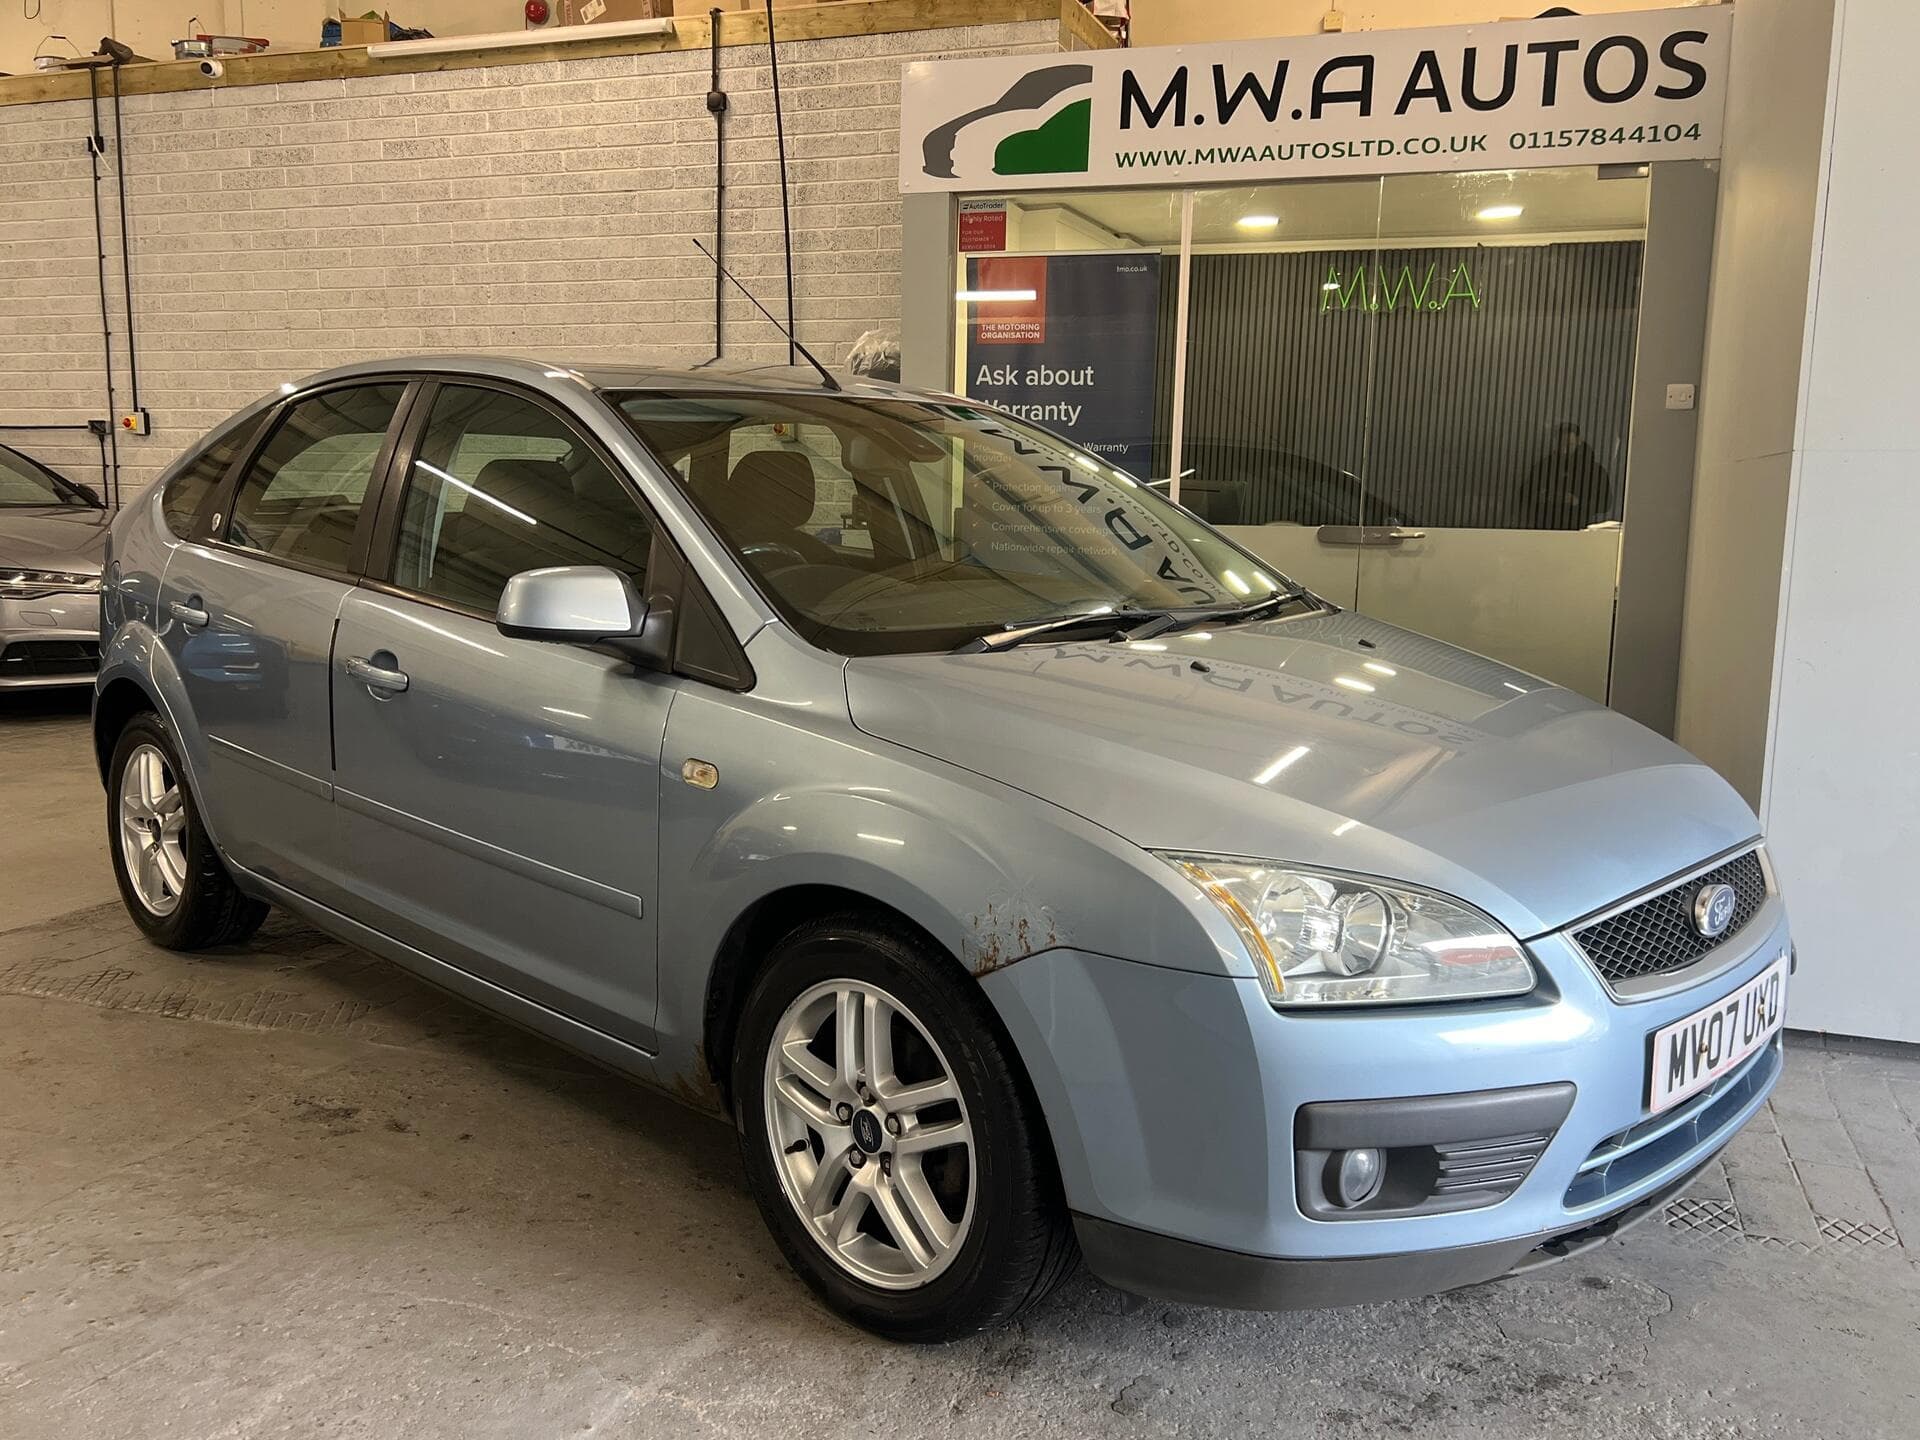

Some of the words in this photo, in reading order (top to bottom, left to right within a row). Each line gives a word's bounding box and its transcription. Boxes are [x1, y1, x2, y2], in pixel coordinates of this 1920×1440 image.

[1119, 54, 1375, 130] M.W.A
[1394, 30, 1709, 116] AUTOS
[1115, 134, 1488, 168] WWW.MWAAUTOSLTD.CO.UK
[1509, 123, 1702, 151] 01157844104
[981, 323, 996, 331] THE
[997, 323, 1040, 332] MOTORING
[981, 331, 1040, 340] ORGANISATION
[976, 364, 1019, 387] Ask
[1025, 364, 1095, 387] about
[1083, 441, 1129, 455] Warranty
[992, 480, 1042, 492] Protection
[991, 502, 1020, 513] Cover
[1023, 502, 1037, 513] for
[1038, 505, 1051, 516] up
[1053, 503, 1064, 514] to
[1065, 503, 1074, 514] 3
[991, 542, 1045, 553] Nationwide
[1667, 999, 1740, 1094] MV07
[1743, 971, 1780, 1046] UXD
